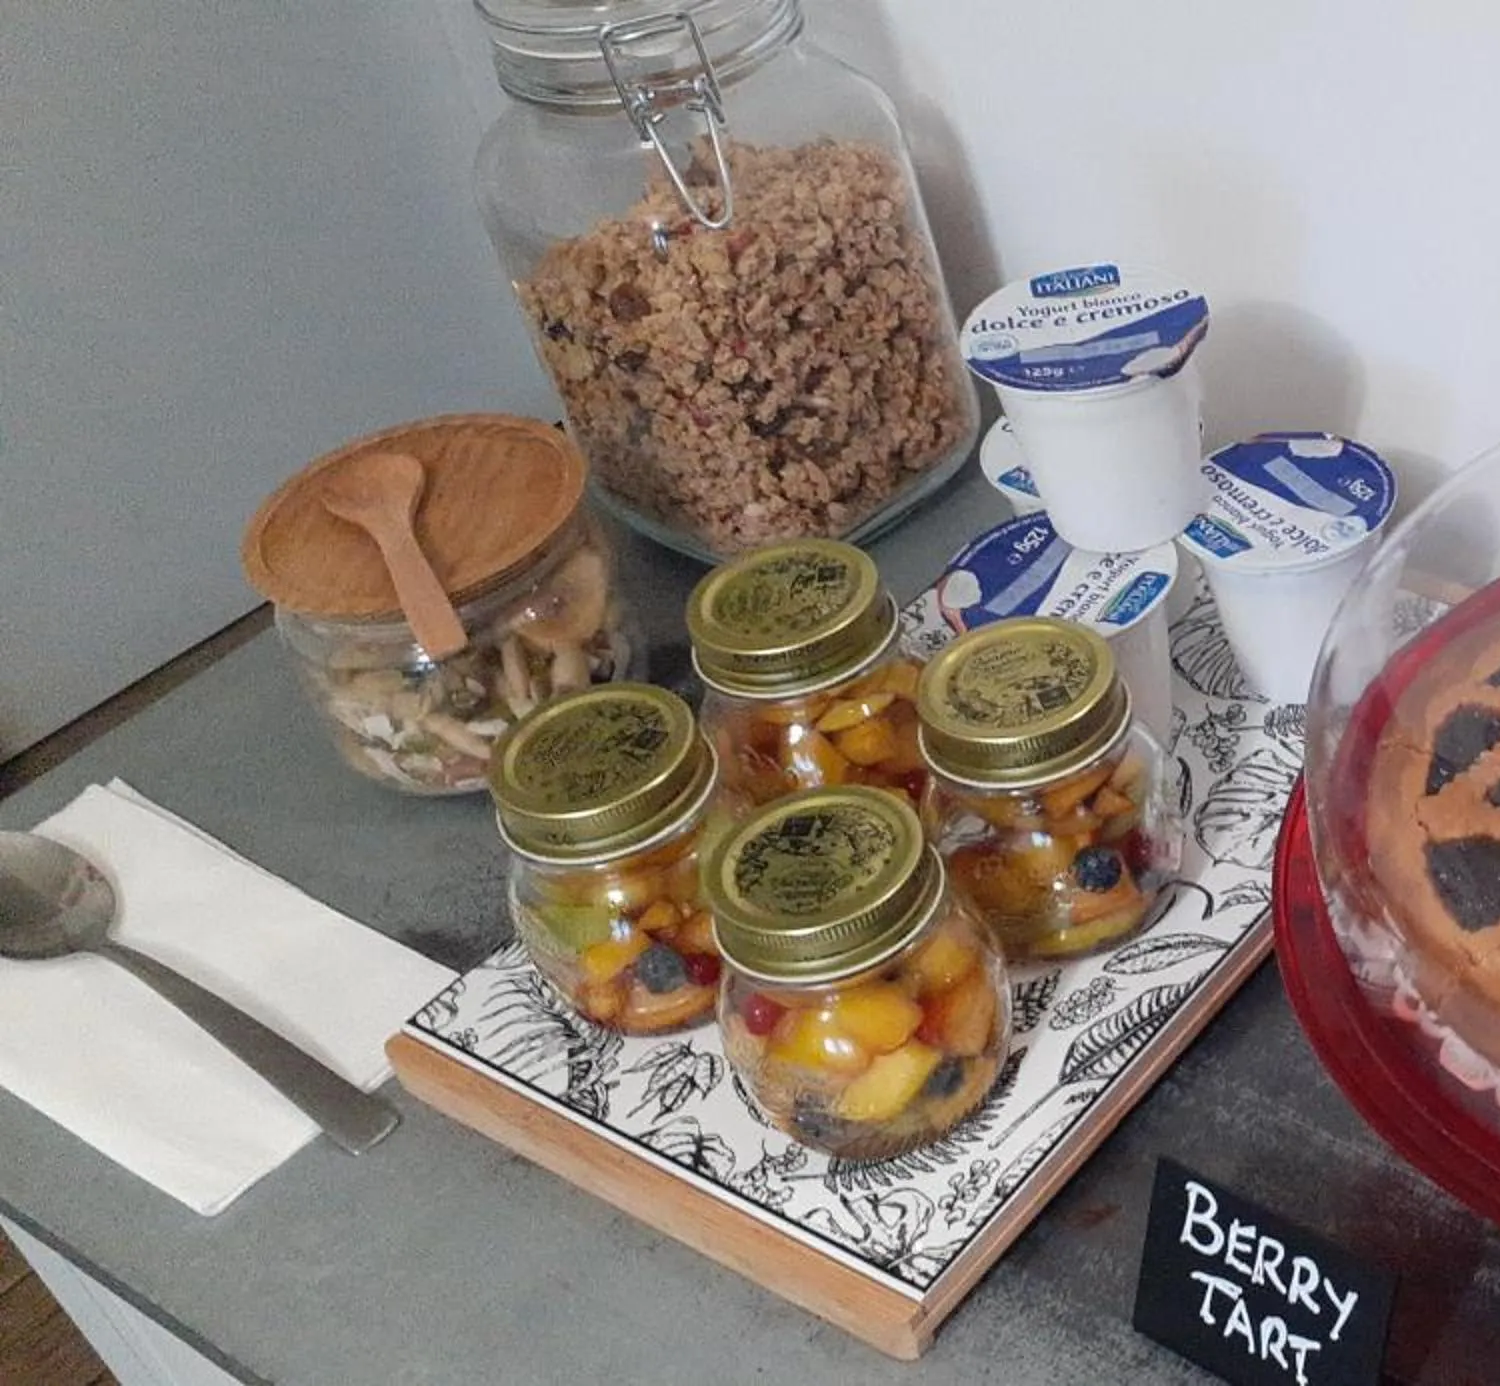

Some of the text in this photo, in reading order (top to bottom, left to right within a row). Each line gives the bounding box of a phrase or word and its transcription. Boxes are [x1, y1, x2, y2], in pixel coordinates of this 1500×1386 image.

[1036, 271, 1115, 293] ITALIANI
[971, 289, 1189, 334] dolce e cremoso
[1016, 293, 1142, 319] Yogurt bianco
[1201, 465, 1273, 520] cremoso
[1014, 527, 1048, 555] 125g
[1282, 525, 1330, 554] dolce
[1180, 1181, 1359, 1341] BERRY
[1190, 1271, 1322, 1386] TART
